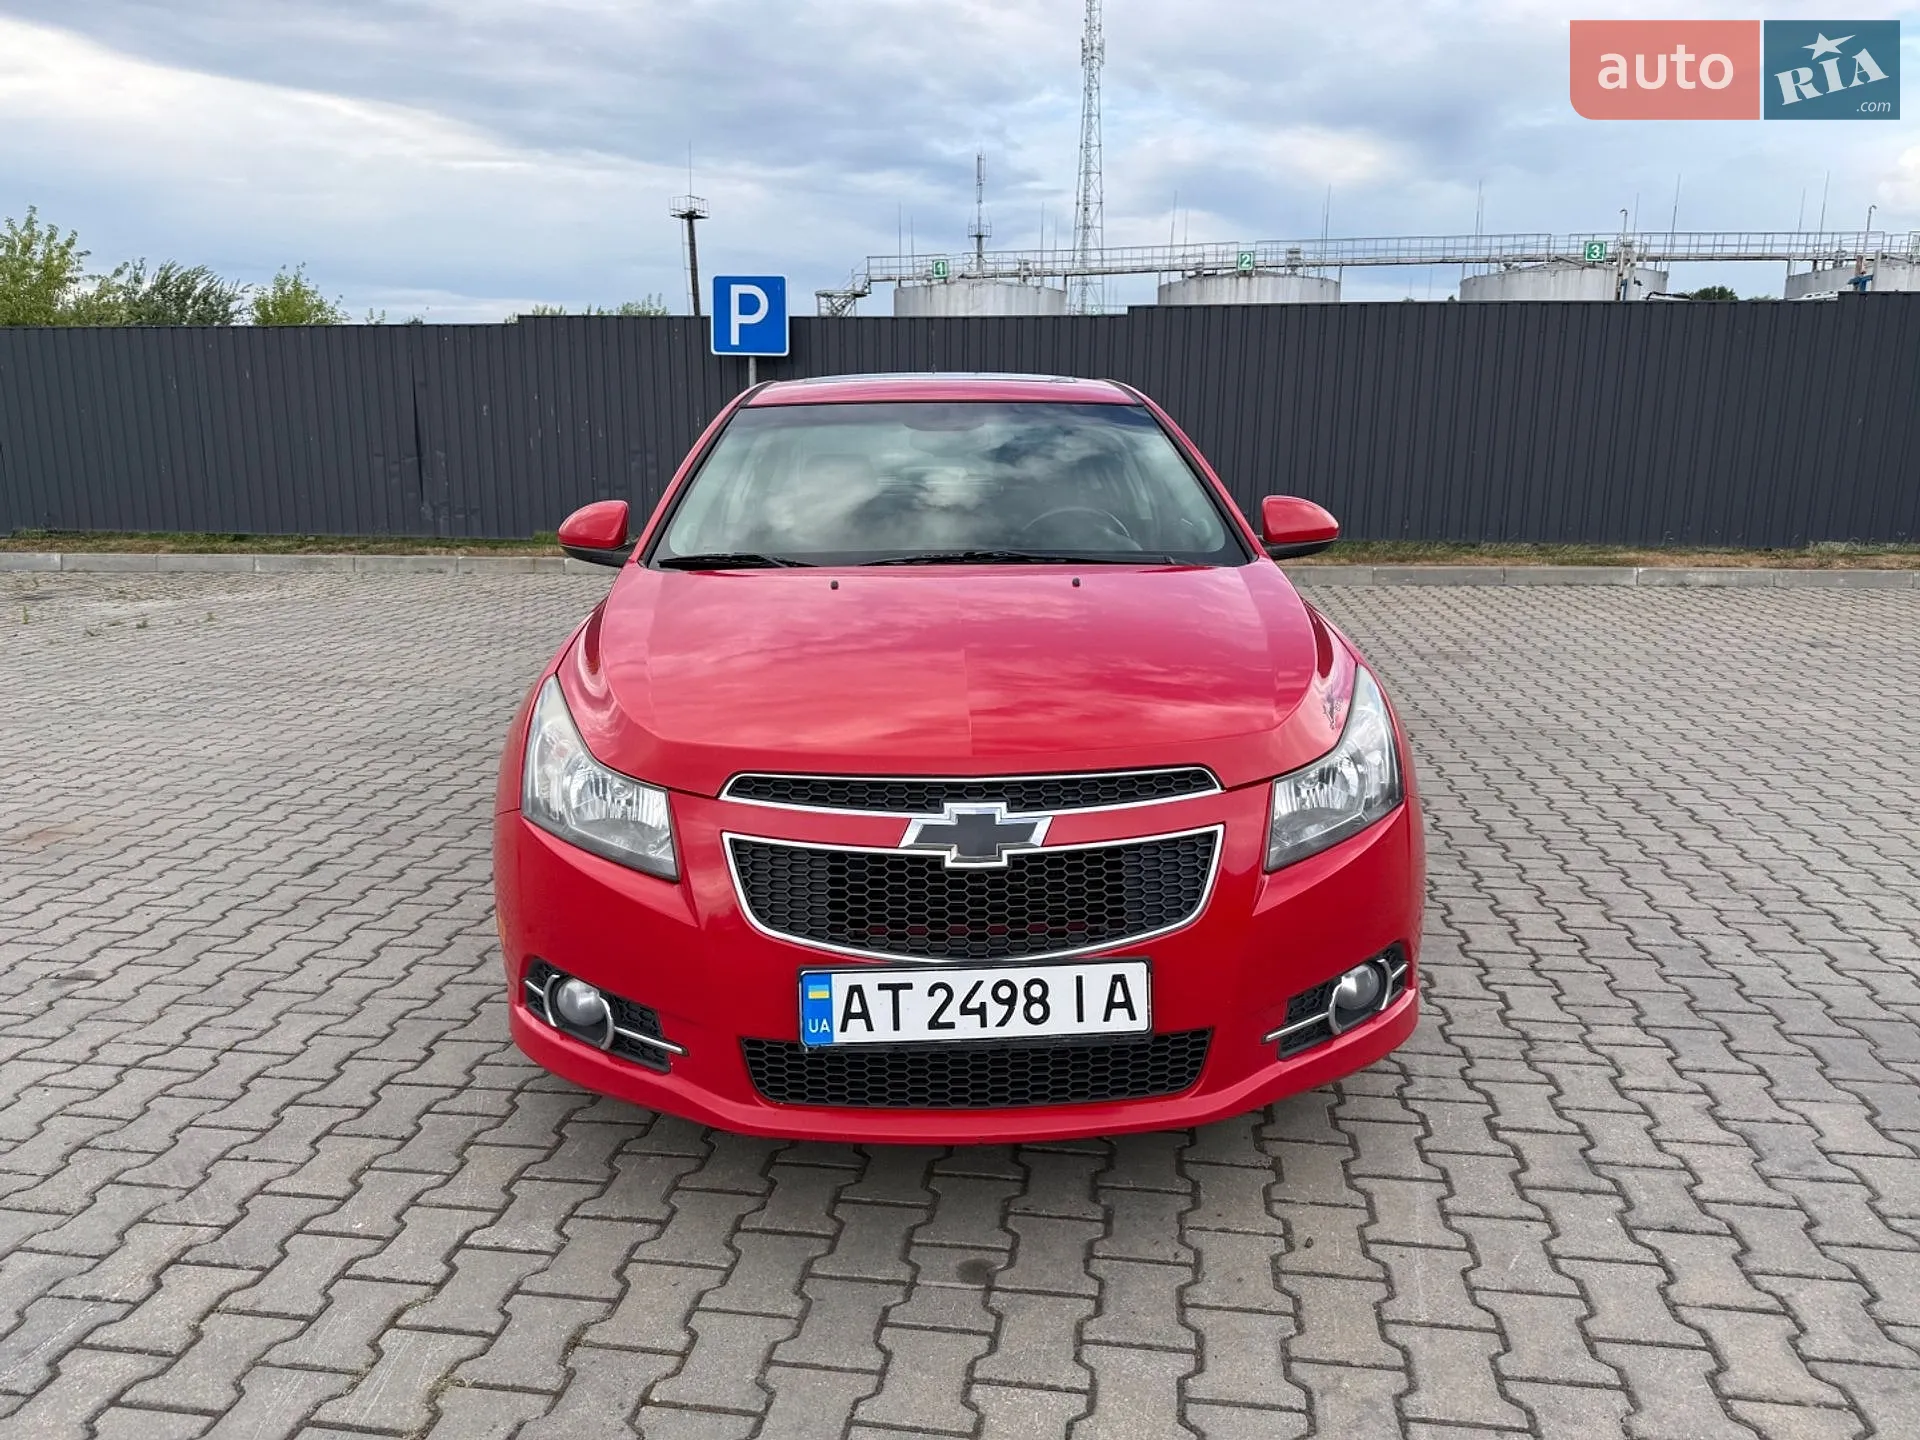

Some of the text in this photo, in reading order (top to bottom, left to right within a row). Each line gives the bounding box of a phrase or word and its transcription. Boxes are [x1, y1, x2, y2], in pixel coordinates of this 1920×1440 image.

[1591, 244, 1600, 258] 3
[936, 262, 943, 275] 1
[1241, 254, 1250, 268] 2
[730, 284, 769, 346] P
[839, 983, 913, 1033] AT
[927, 978, 1050, 1031] 2498
[808, 1018, 831, 1034] UA
